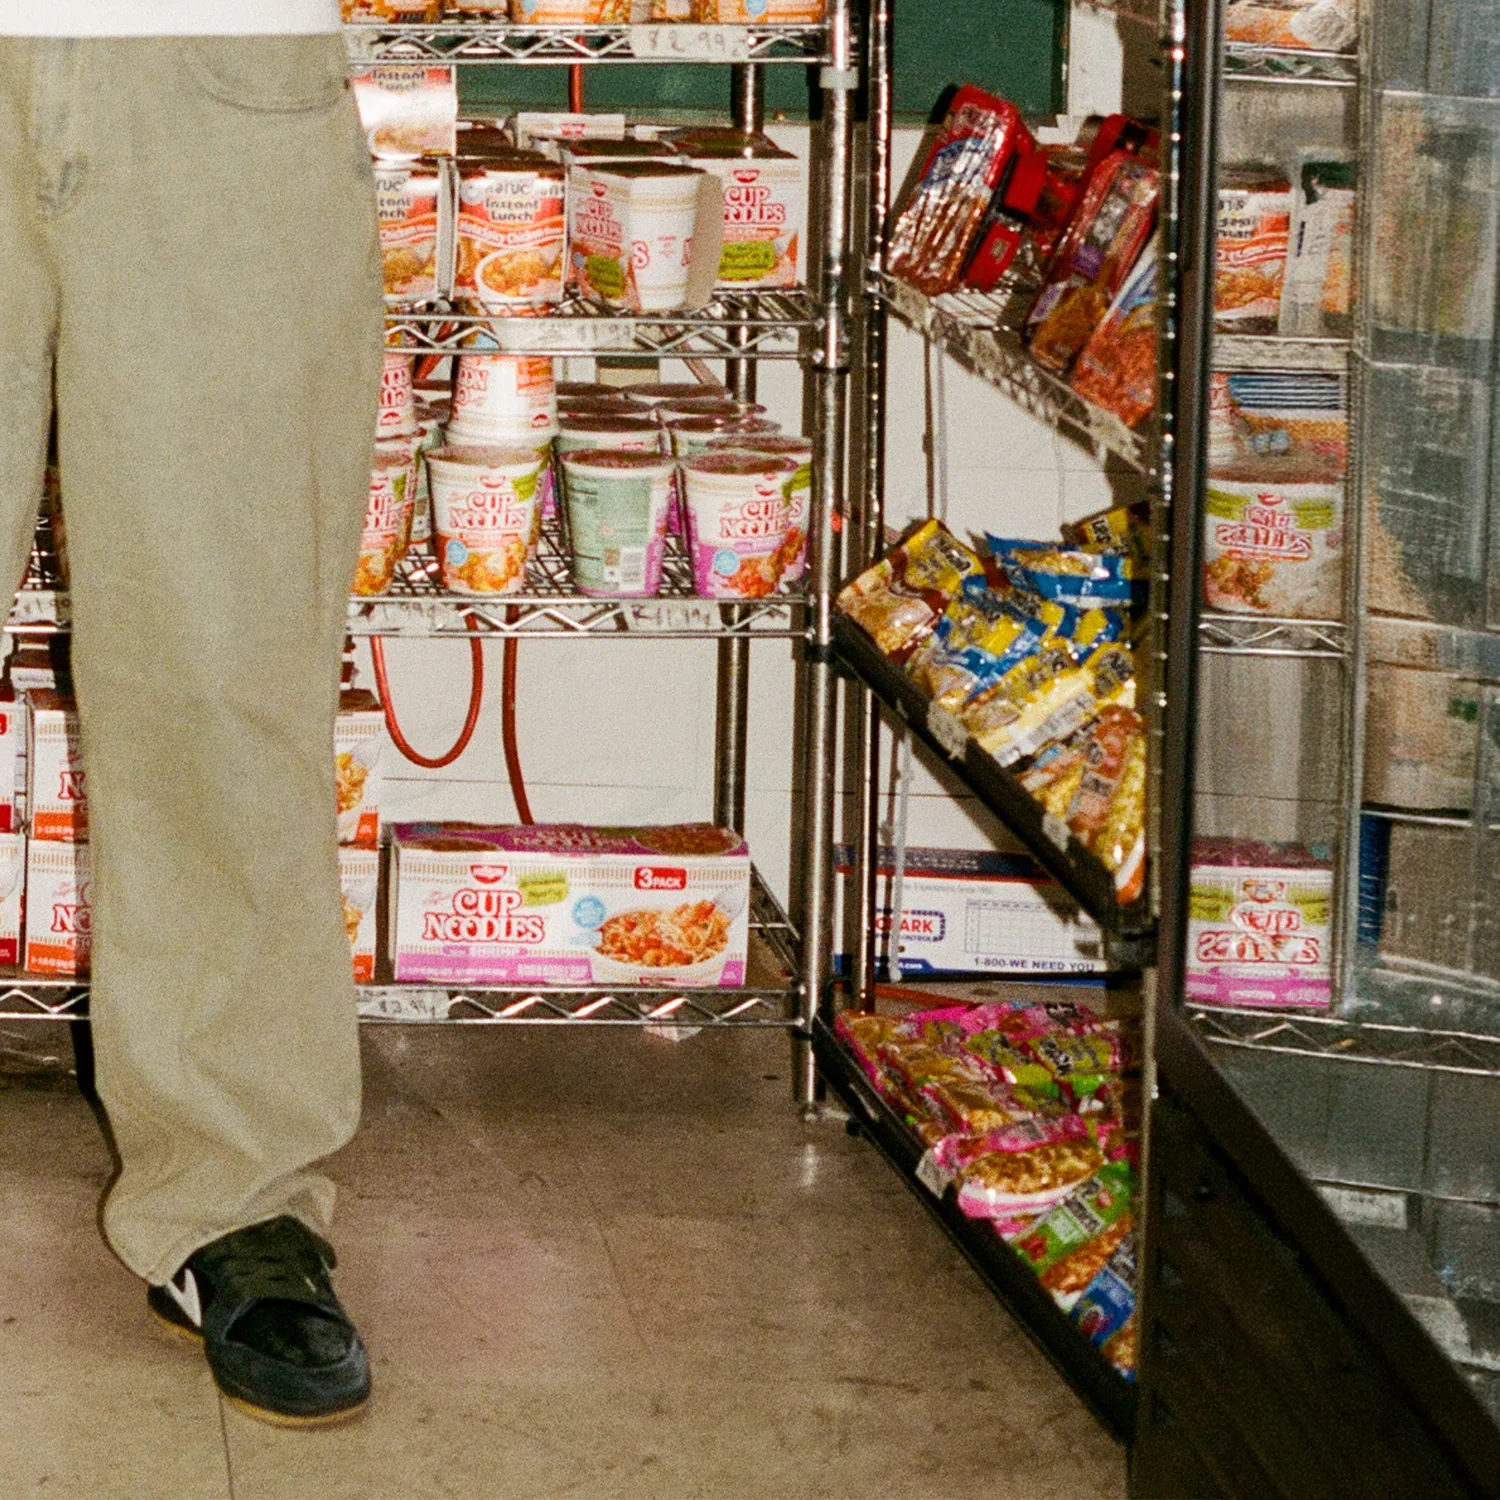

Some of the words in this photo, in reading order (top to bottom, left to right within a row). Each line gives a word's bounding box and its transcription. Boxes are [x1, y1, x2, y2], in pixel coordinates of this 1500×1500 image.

[725, 184, 770, 207] CUP
[452, 888, 523, 917] CUP
[422, 912, 546, 944] NOODLES
[875, 917, 934, 934] CARK
[1031, 959, 1065, 971] NEED
[1068, 961, 1096, 973] YOU
